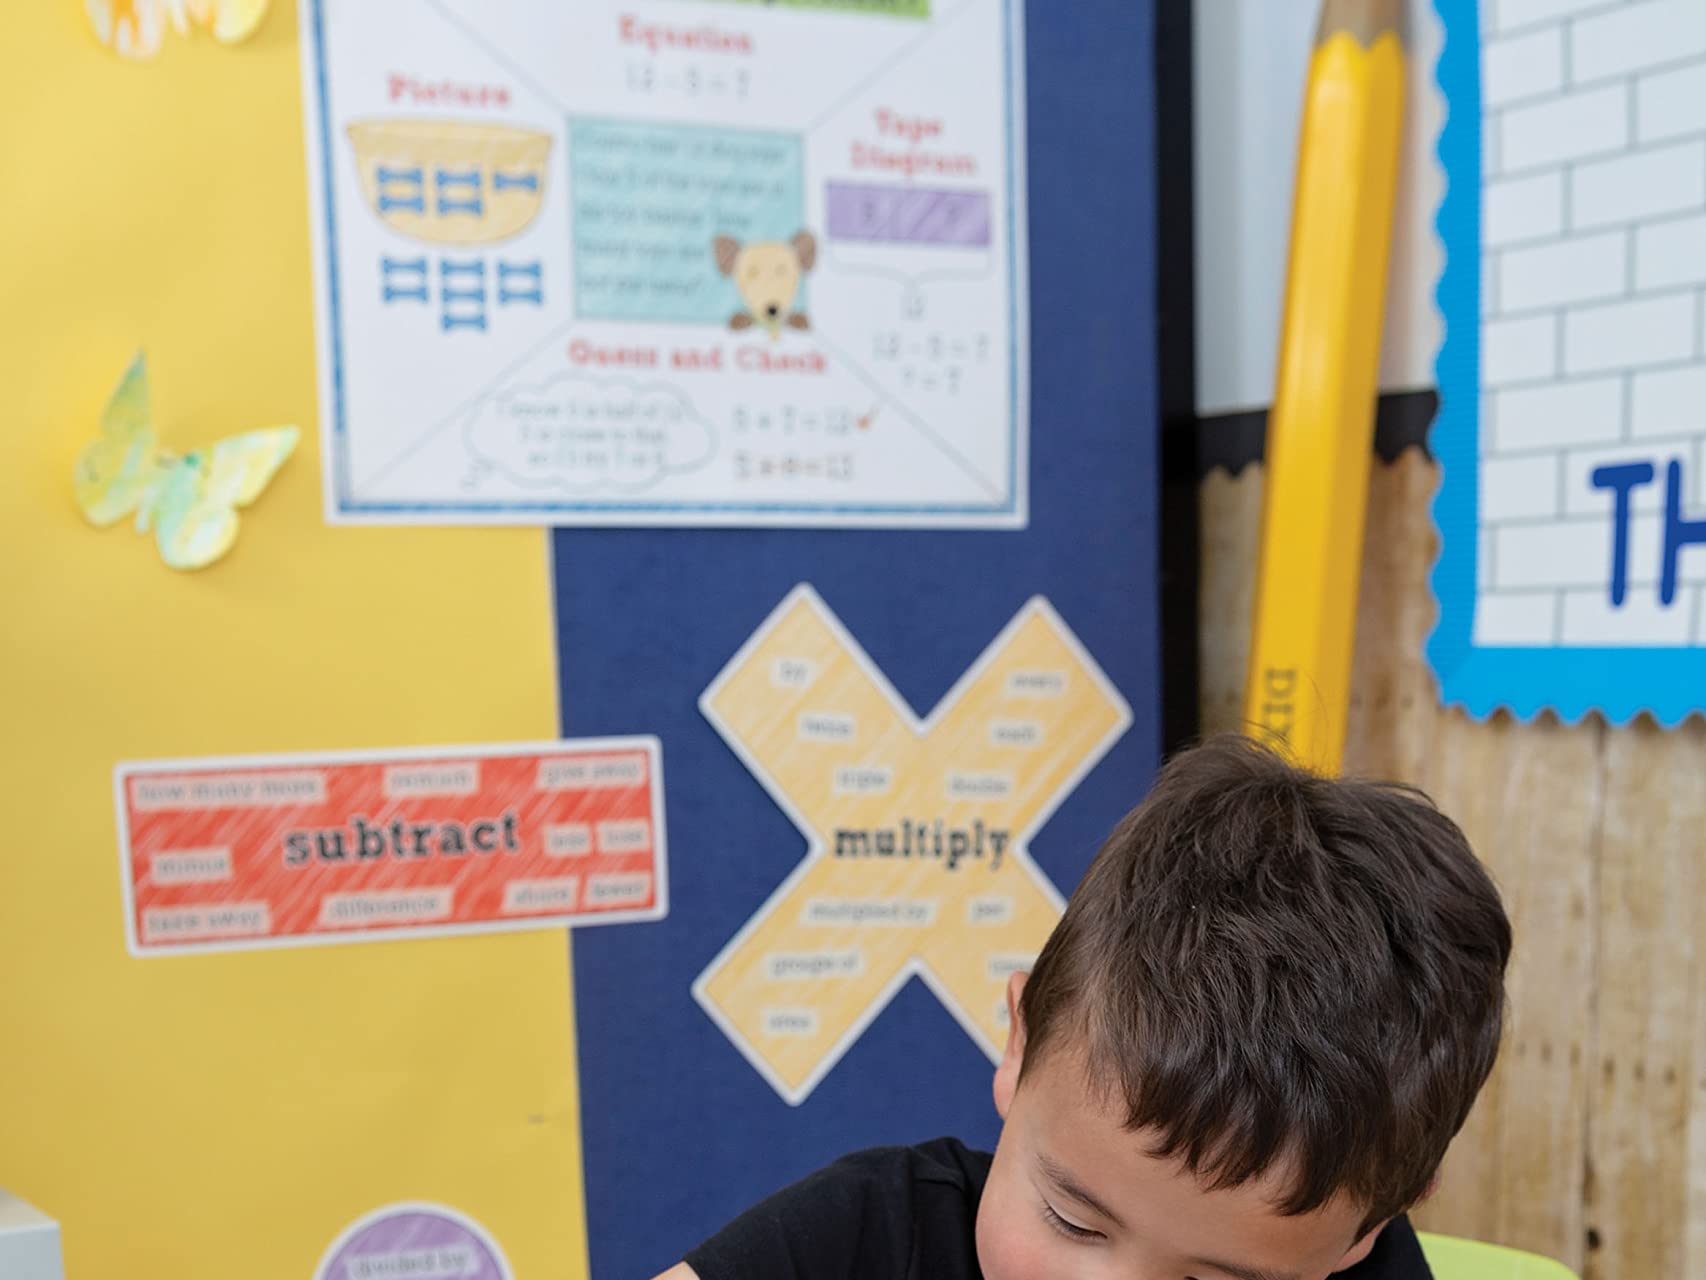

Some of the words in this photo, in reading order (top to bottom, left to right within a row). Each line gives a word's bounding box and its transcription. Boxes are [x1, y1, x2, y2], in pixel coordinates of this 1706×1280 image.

[387, 74, 510, 108] Picture
[874, 107, 945, 141] Tape
[670, 343, 723, 372] and
[285, 813, 520, 867] subtract
[834, 819, 1009, 870] multiply
